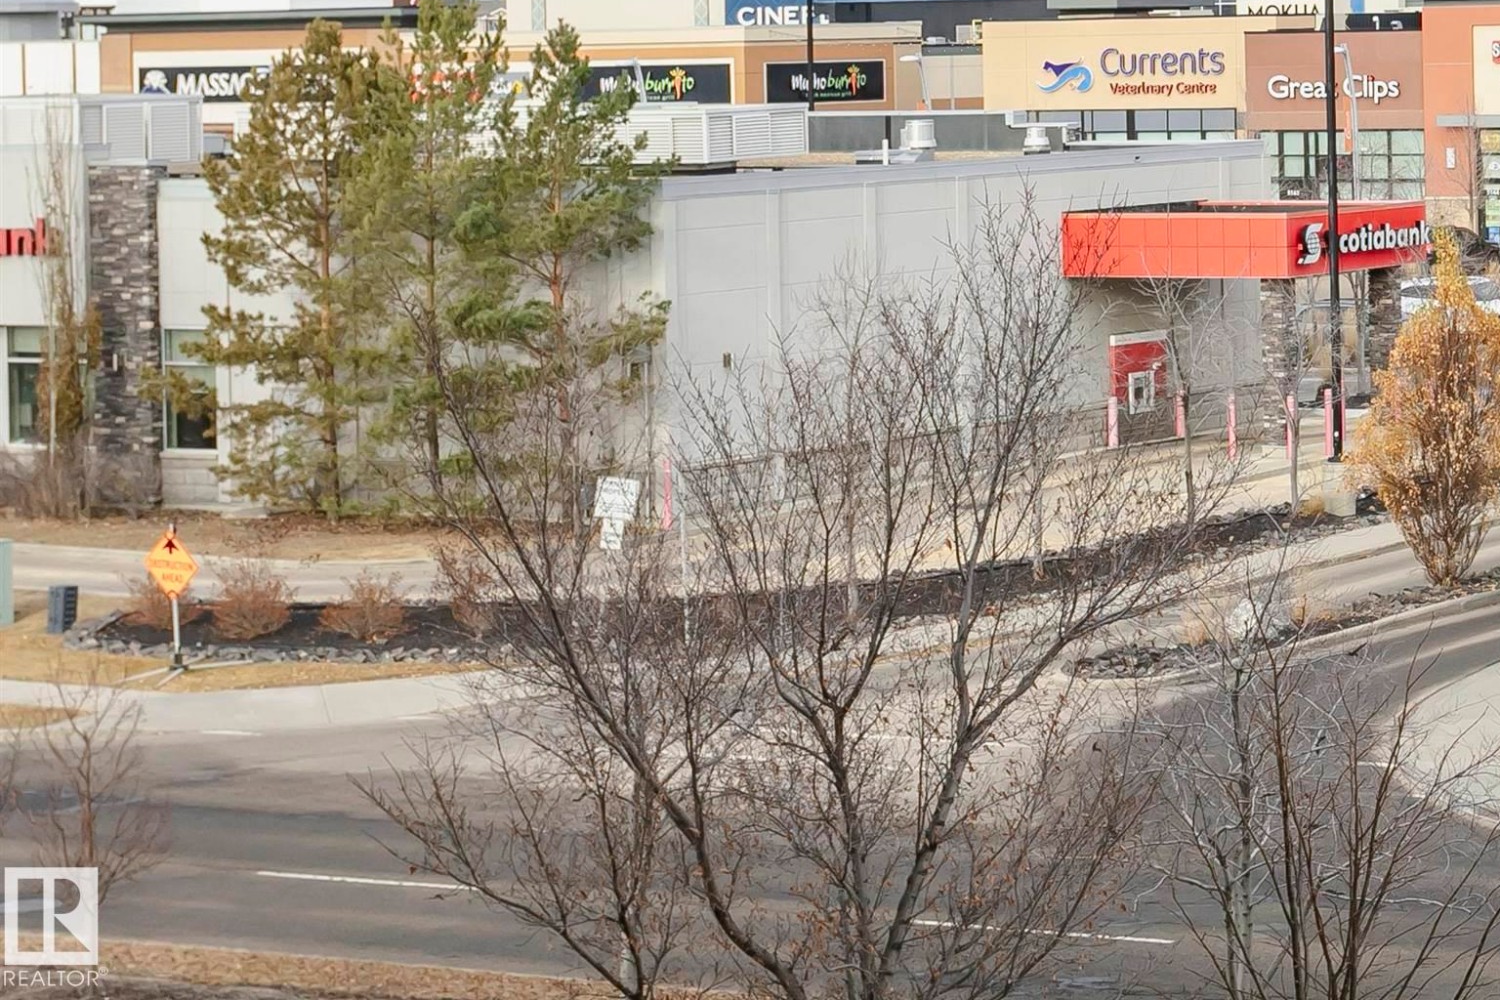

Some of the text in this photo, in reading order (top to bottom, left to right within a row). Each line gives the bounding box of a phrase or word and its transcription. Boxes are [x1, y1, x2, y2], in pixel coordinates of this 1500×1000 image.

[1100, 48, 1226, 77] Currents
[1176, 82, 1217, 94] Centre
[1267, 75, 1400, 104] Grea Clips
[1326, 220, 1430, 254] cotiabank
